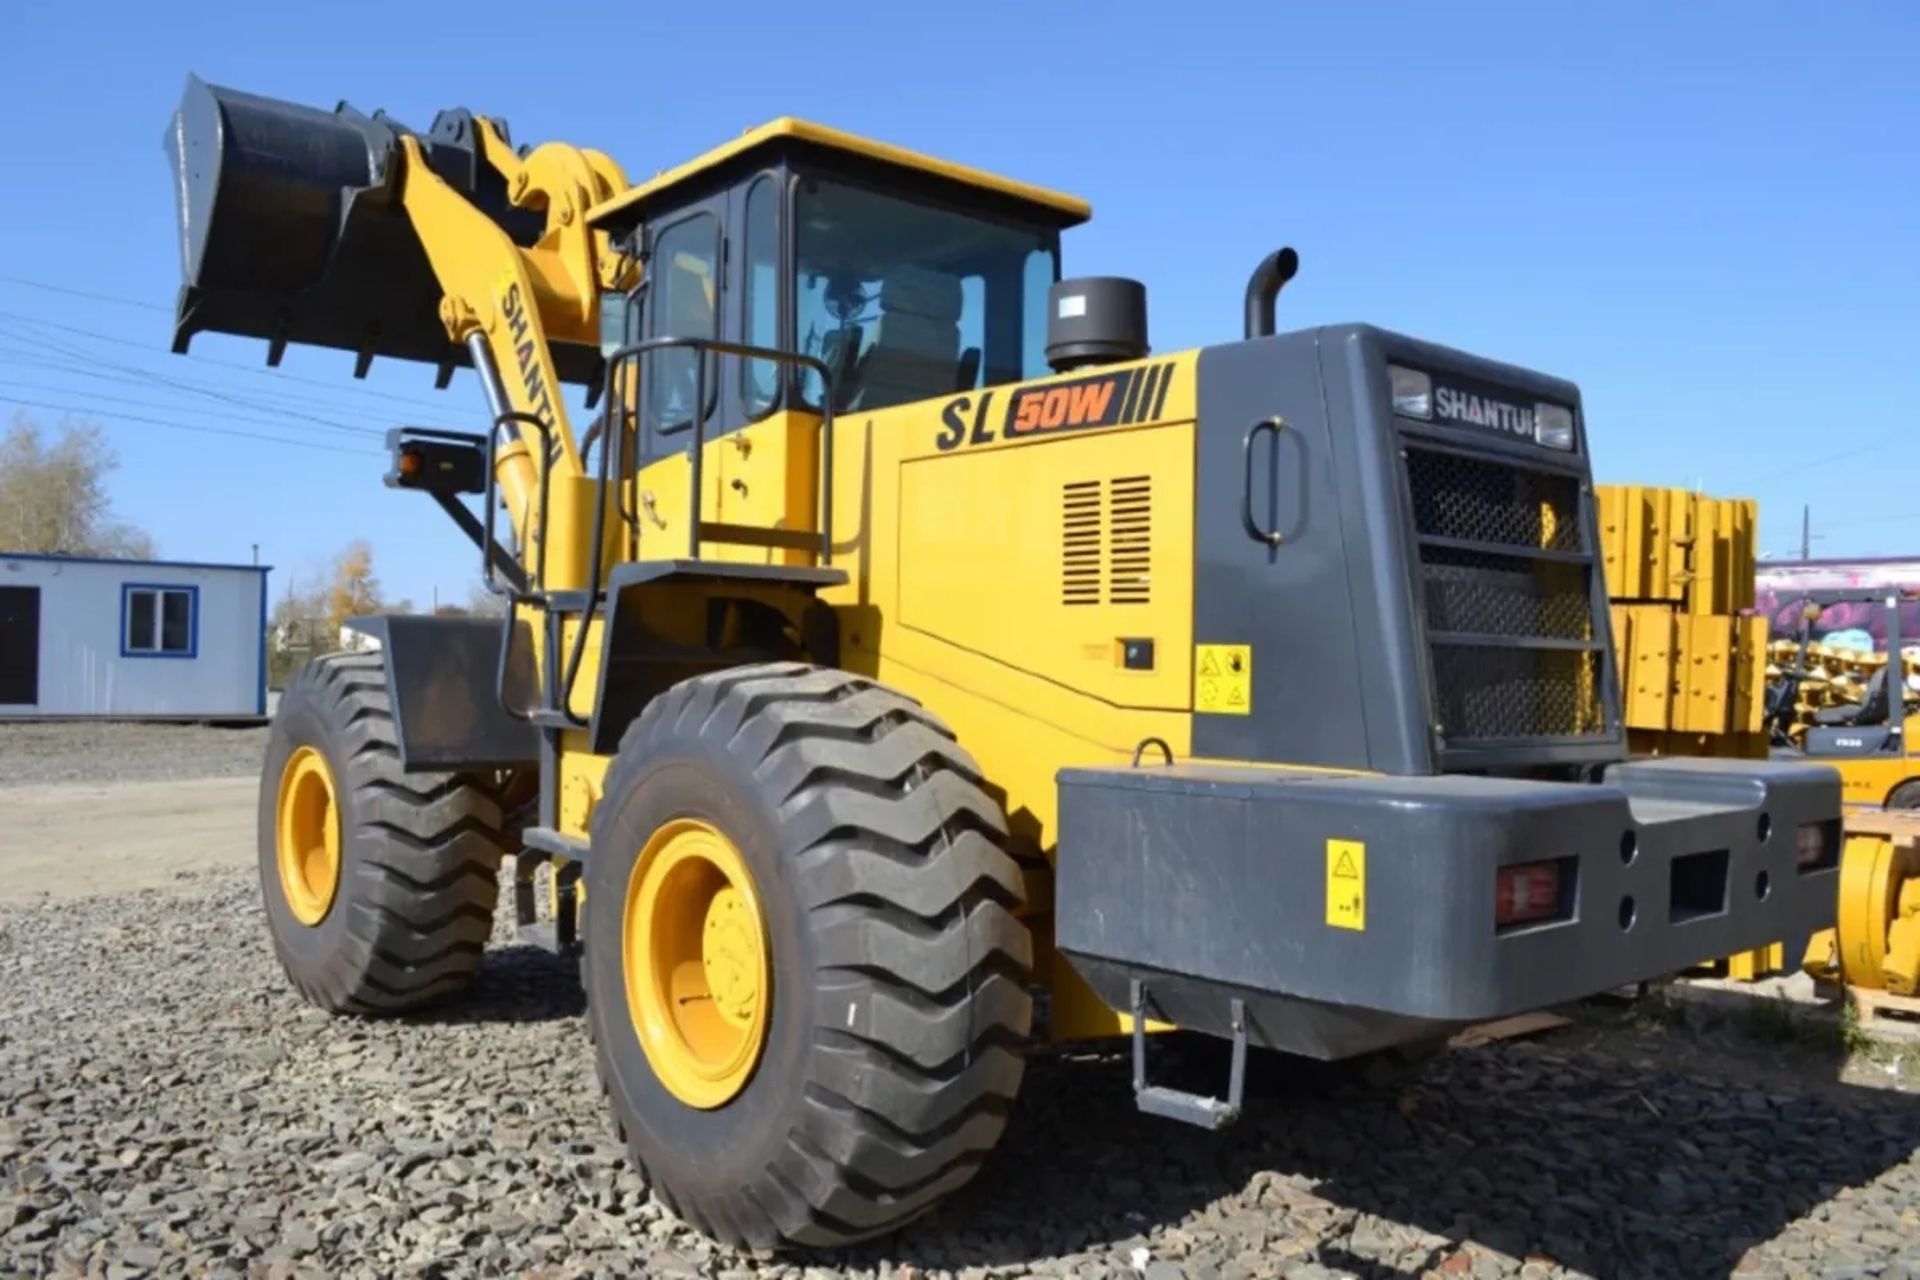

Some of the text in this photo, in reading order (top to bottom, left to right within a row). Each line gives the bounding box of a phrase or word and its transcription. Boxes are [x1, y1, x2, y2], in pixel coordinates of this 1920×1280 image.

[936, 381, 1115, 450] SL 50W
[1435, 386, 1533, 436] SHANTUI
